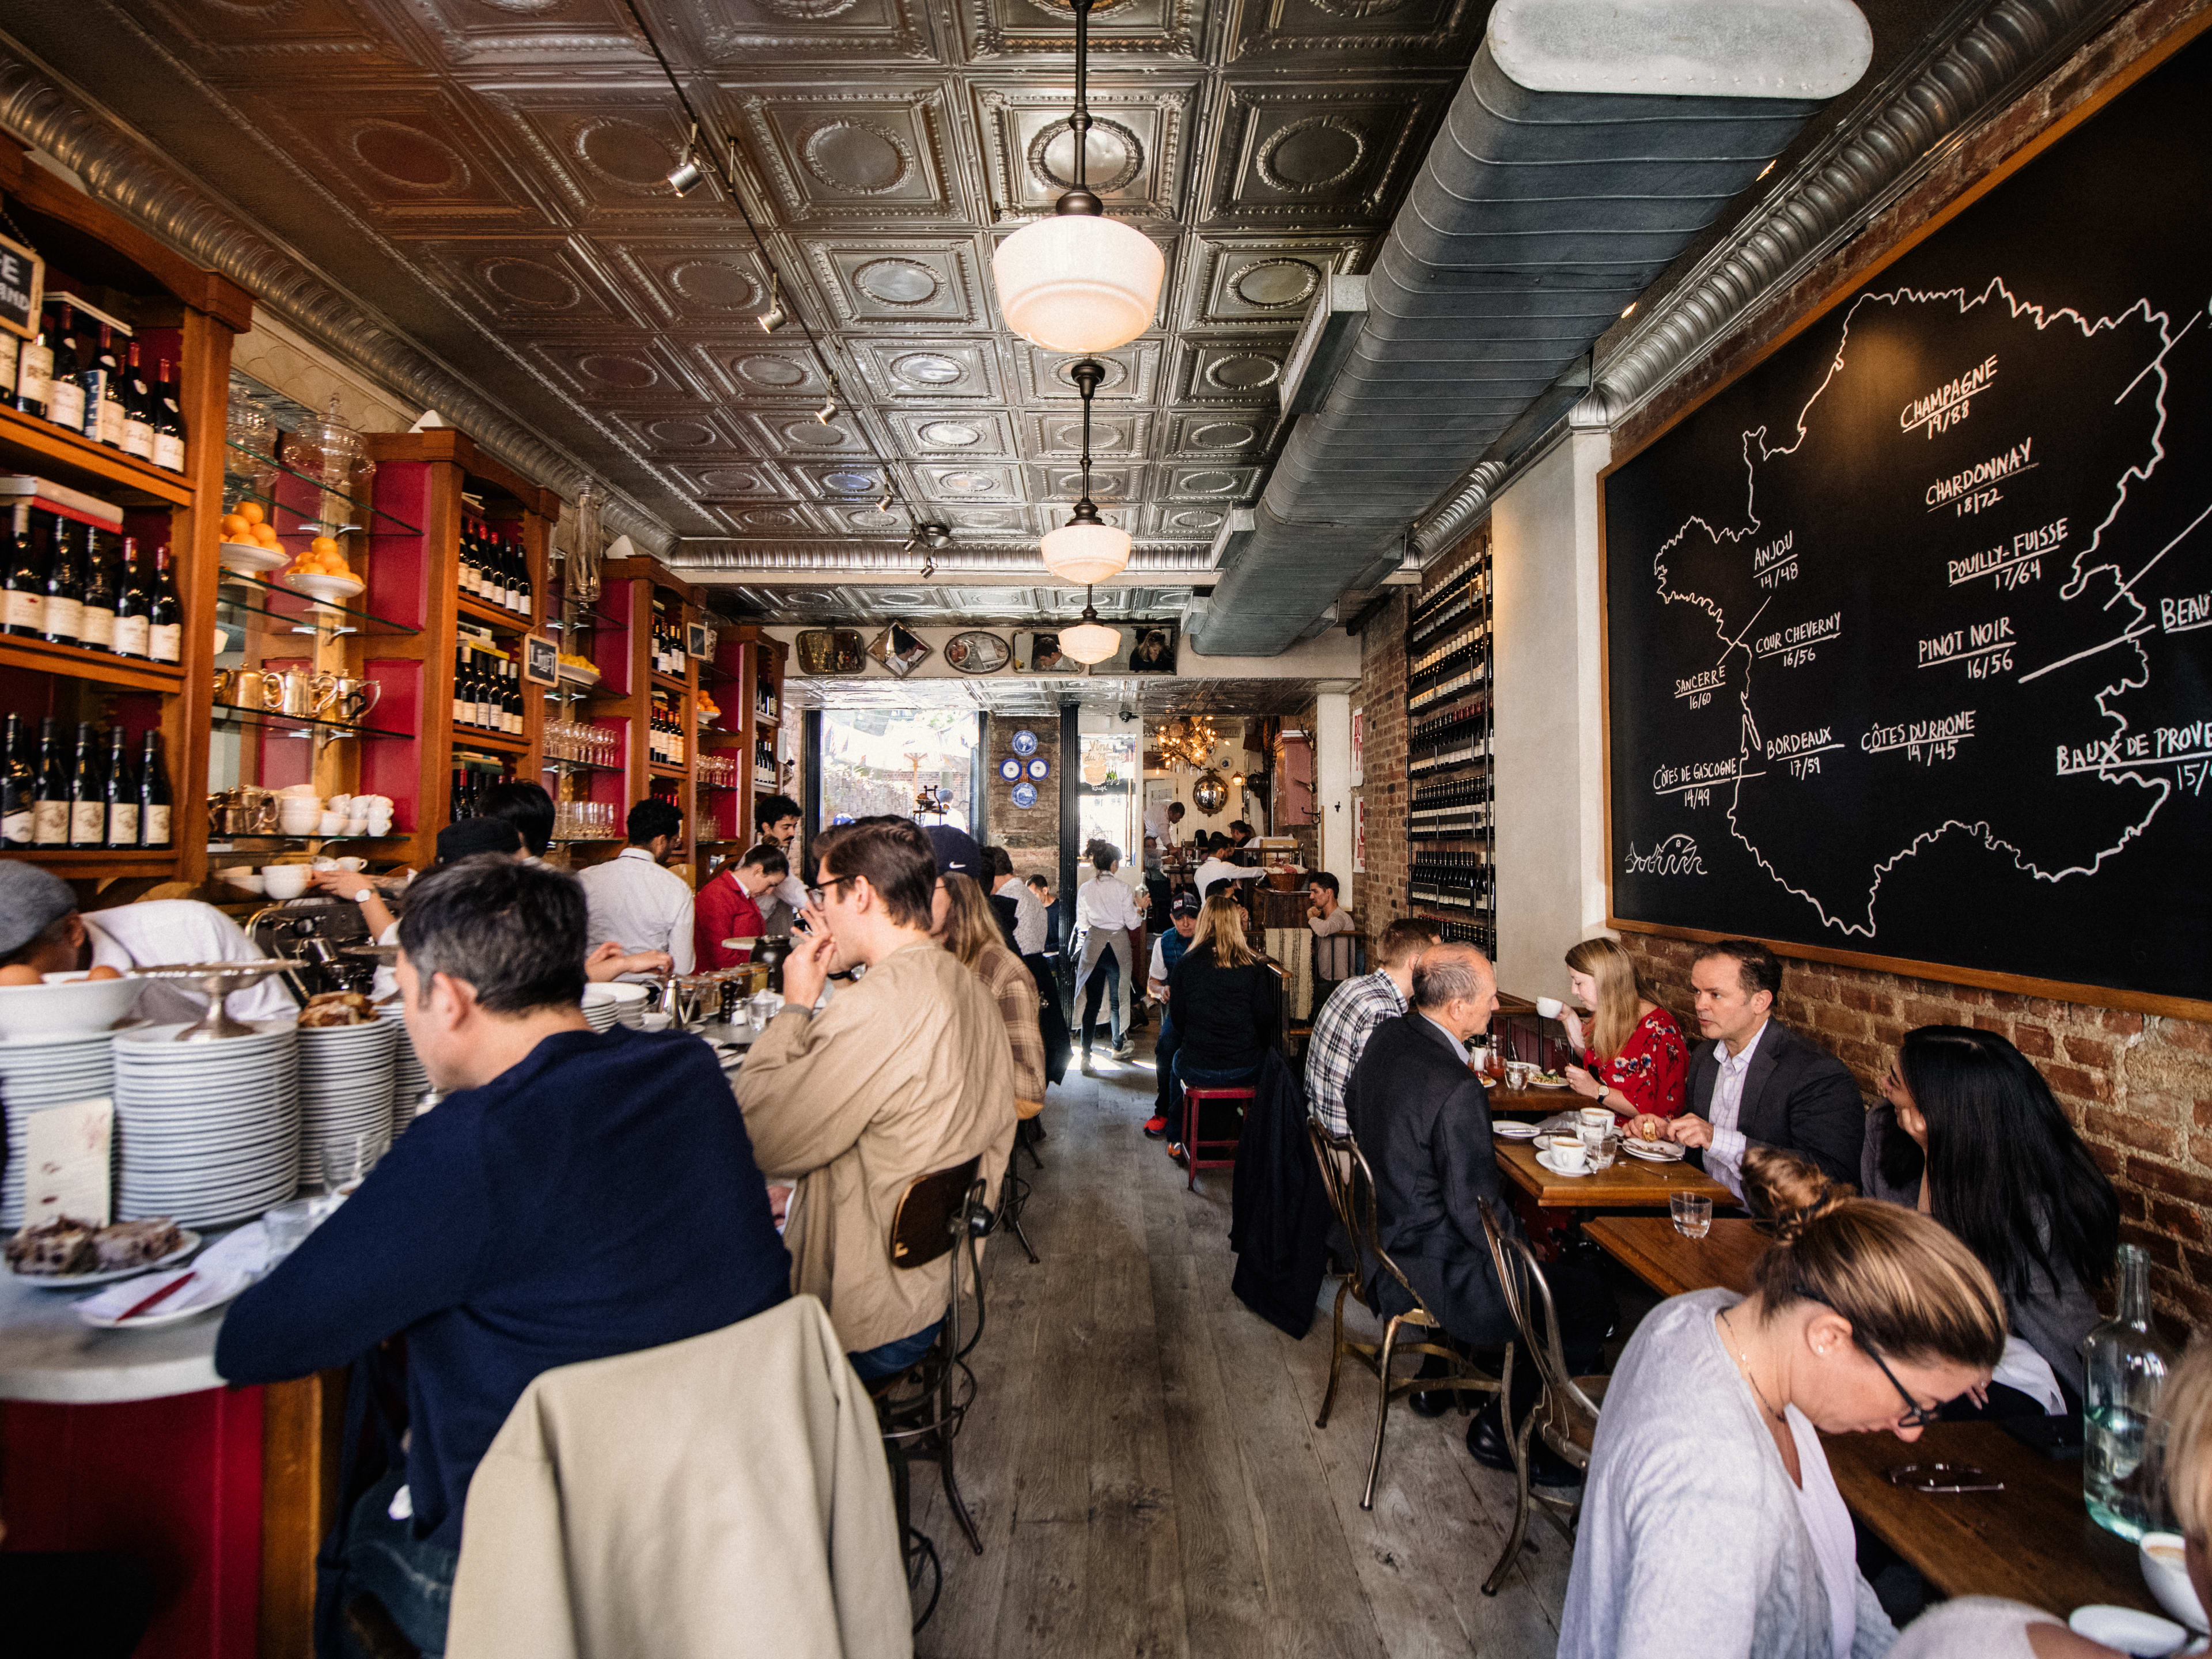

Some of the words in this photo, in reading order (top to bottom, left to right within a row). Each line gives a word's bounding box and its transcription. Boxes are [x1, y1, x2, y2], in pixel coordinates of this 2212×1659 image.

[1900, 354, 1998, 428] CHAMPAGNE
[1928, 399, 1969, 440] 19/88
[1925, 436, 2032, 505] CHARDONNAY
[1754, 530, 1793, 571] ANJOU
[1760, 562, 1798, 589] 14/48
[1995, 558, 2041, 591] 17/64
[2160, 590, 2212, 630] BEAU
[1756, 632, 1782, 653] COUR
[1785, 611, 1841, 643] CHEVERNY
[1918, 630, 1964, 663] PINOT
[1970, 616, 2014, 647] NOIR
[1783, 647, 1816, 668] 16/56
[1967, 648, 2013, 680] 16/56
[1674, 665, 1726, 695] SANCERRE
[1690, 692, 1711, 710] 16/60
[1767, 726, 1832, 760] BORDEAUX
[1861, 722, 1906, 751] CÔTES
[1909, 719, 1926, 742] DU
[1929, 710, 1976, 740] RHONE
[2056, 740, 2123, 774] BAUX
[2126, 733, 2149, 756] DE
[2153, 720, 2212, 758] PROVE
[1653, 764, 1678, 790] CÔTES
[1681, 765, 1691, 782] DE
[1693, 757, 1737, 779] GASCOGNE
[1790, 756, 1820, 781] 17/59
[2176, 760, 2212, 797] 15/
[1684, 788, 1710, 809] 14/49
